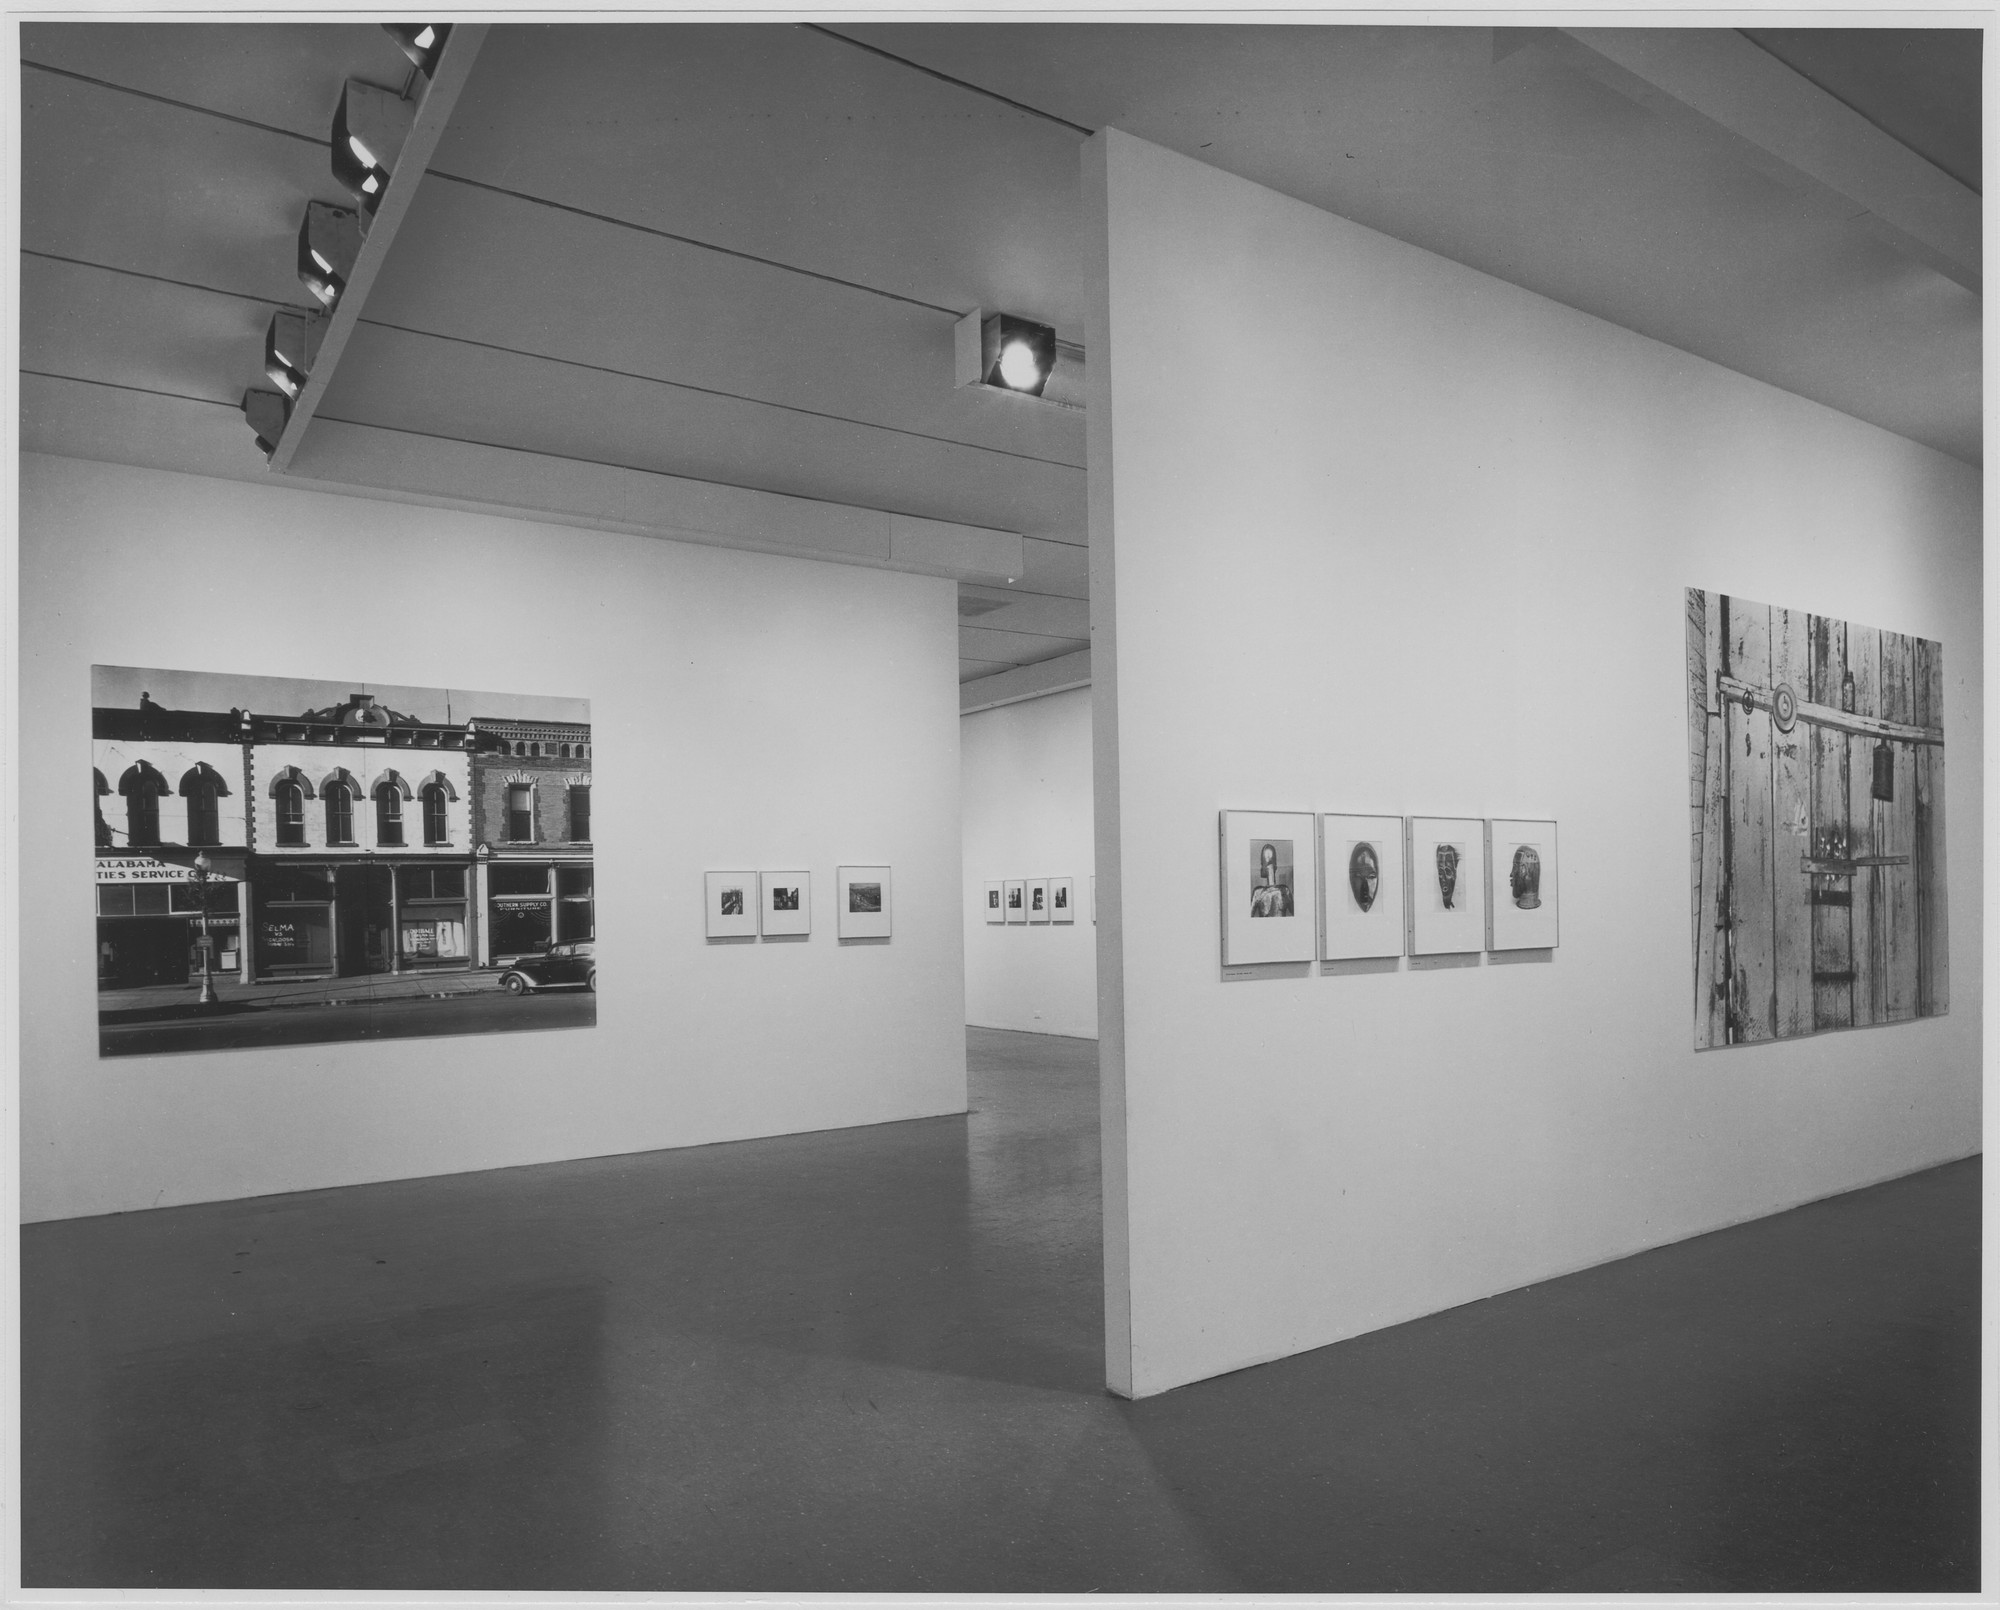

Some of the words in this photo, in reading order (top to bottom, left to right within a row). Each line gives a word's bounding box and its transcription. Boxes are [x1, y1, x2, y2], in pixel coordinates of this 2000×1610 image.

[96, 871, 126, 879] TIES
[131, 870, 184, 879] SERVICE
[263, 921, 294, 931] SELMA
